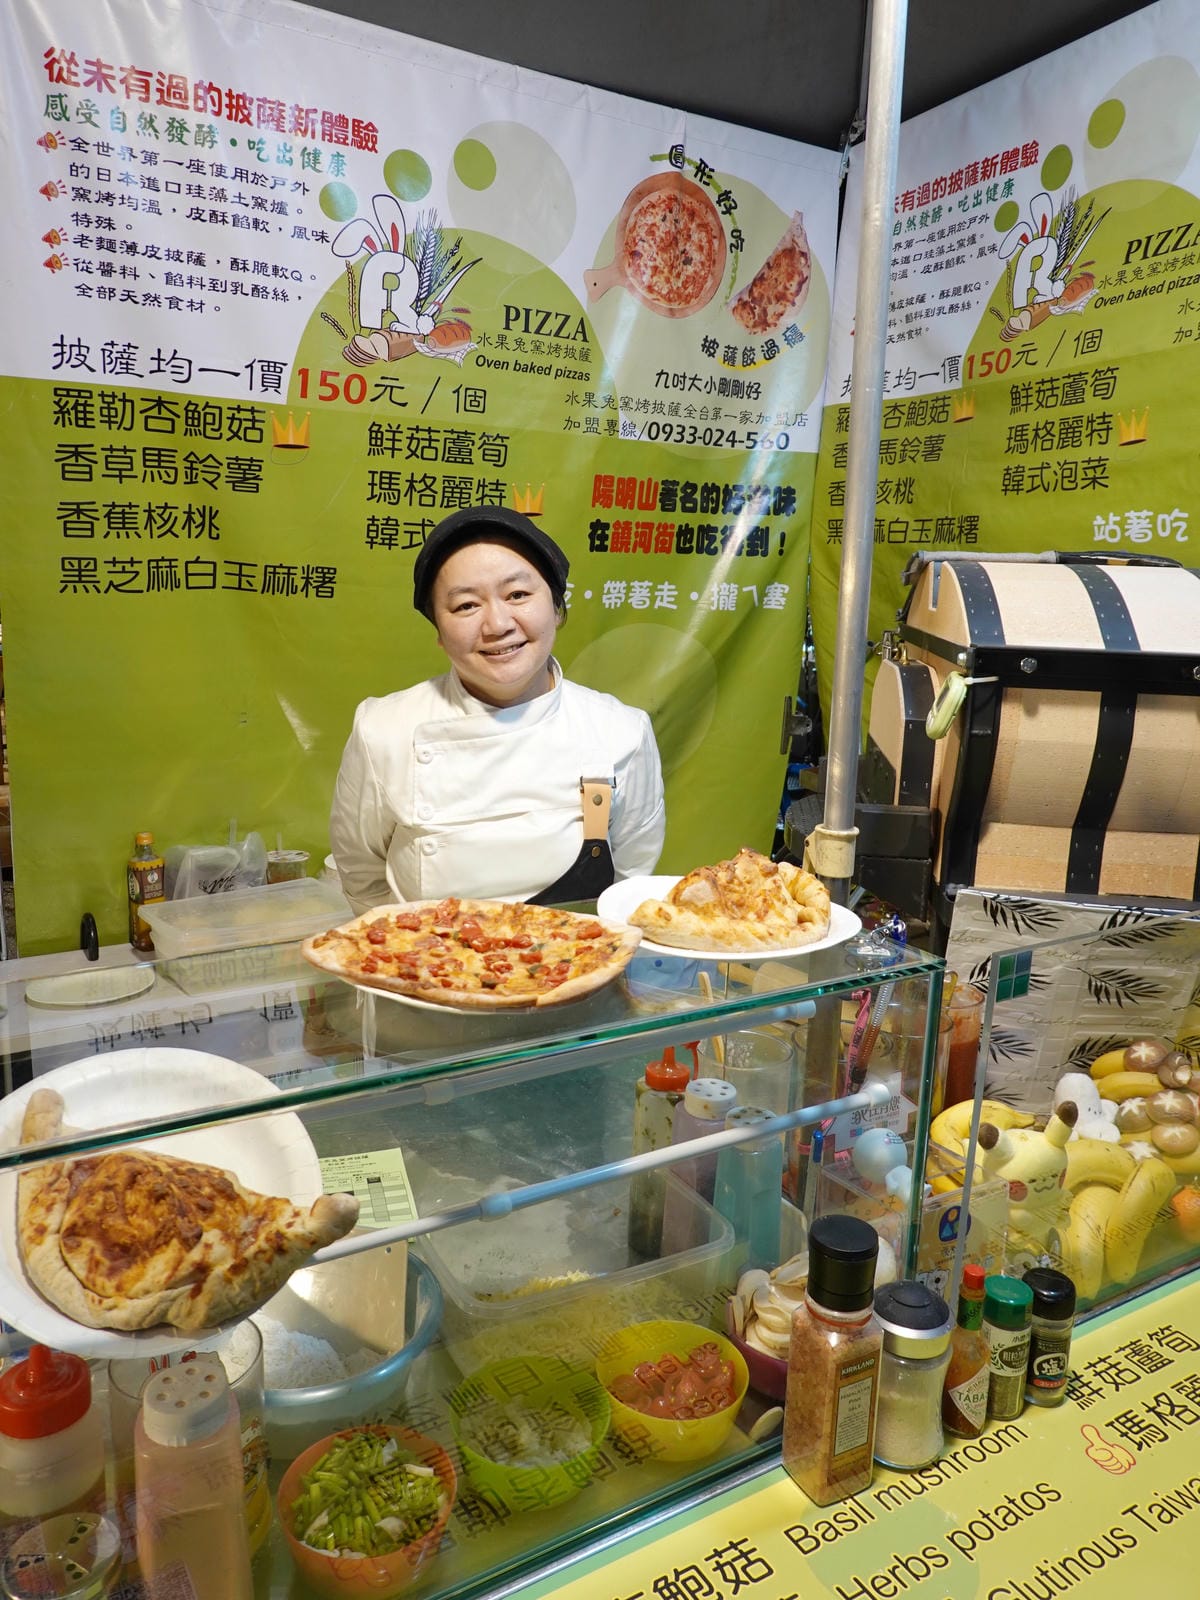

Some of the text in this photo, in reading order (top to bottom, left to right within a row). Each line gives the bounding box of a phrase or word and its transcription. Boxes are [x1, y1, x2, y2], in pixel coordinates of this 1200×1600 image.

[43, 46, 379, 154] 從未有過的披薩新體驗
[68, 136, 311, 196] 全世界第一座使用於戶外
[71, 212, 133, 231] 特殊。
[1099, 252, 1200, 289] 水果兔窯烤披
[75, 282, 221, 314] 全部天然食材。
[1094, 293, 1124, 309] Oven
[1126, 280, 1166, 301] baked
[1177, 297, 1200, 315] 水
[503, 305, 590, 343] PIZZA
[477, 332, 593, 363] 水果兔窯烤披薩
[475, 354, 591, 382] Oven baked pizzas
[655, 369, 762, 400] 九吋大小剛剛好
[1009, 365, 1119, 416] 鮮菇蘆筍
[52, 387, 265, 444] 羅勒杏鮑菇
[835, 396, 951, 433] 羅杏鮑菇
[1004, 411, 1113, 455] 瑪格麗特
[367, 420, 510, 468] 鮮菇蘆筍
[832, 434, 946, 469] 香馬鈴薯
[53, 442, 264, 495] 香草馬鈴薯
[1001, 455, 1110, 497] 韓式泡菜
[366, 469, 508, 509] 瑪格麗特
[56, 501, 221, 541] 香蕉核桃
[827, 515, 980, 545] 黑麻白玉麻糬
[1092, 508, 1189, 543] 站著吃
[59, 556, 337, 600] 黑芝麻白玉麻糬
[841, 1358, 875, 1376] KIRKLAND
[1064, 1324, 1200, 1410] 鮮菇蘆筍
[614, 1537, 774, 1600] 鮑菇
[783, 1492, 877, 1555] Basil
[873, 1423, 1029, 1512] mushroom
[946, 1482, 1062, 1562] potatos
